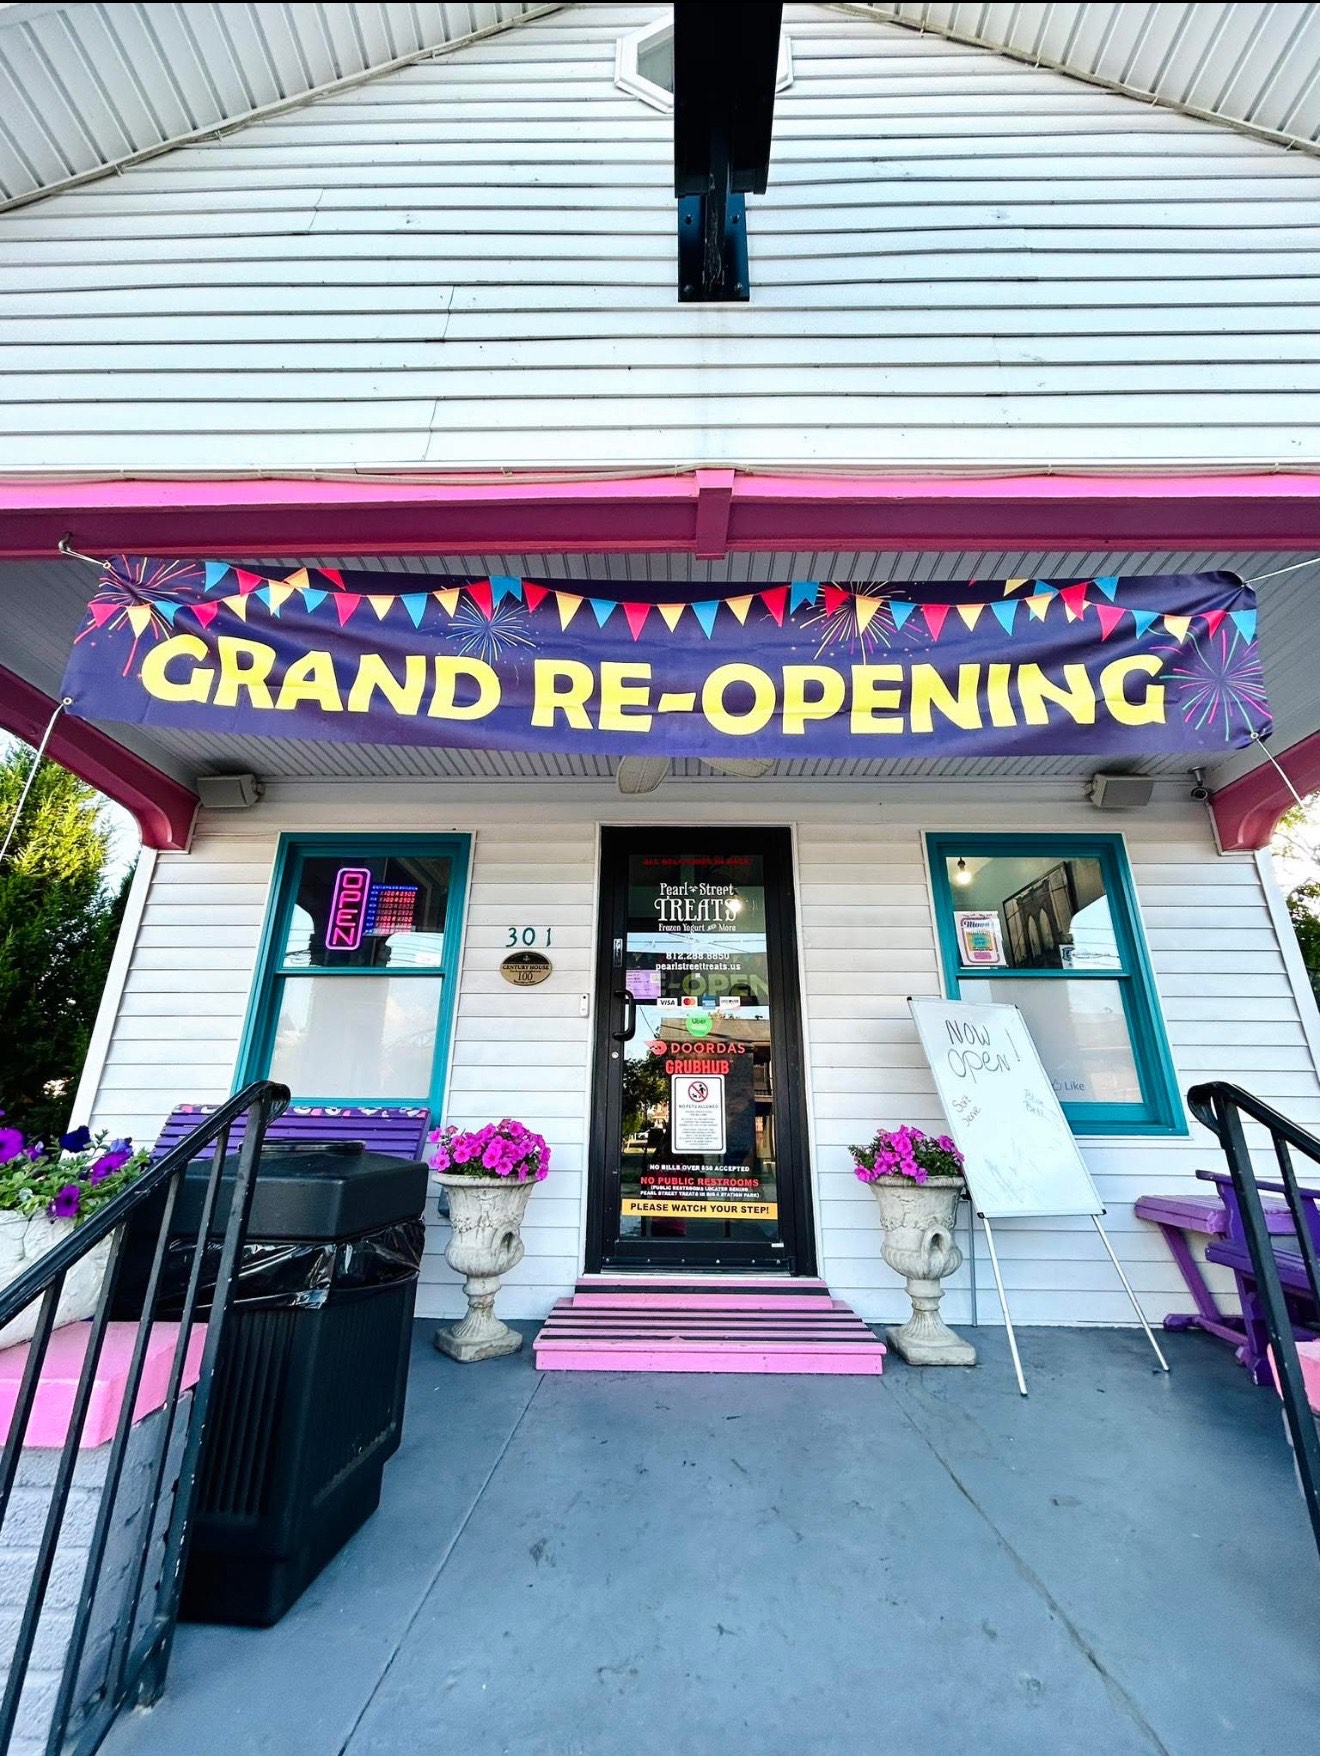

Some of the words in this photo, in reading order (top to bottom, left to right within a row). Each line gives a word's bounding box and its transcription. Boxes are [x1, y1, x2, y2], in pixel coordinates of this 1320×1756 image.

[140, 633, 501, 721] GRAND
[531, 653, 1166, 735] RE-OPENING
[660, 881, 689, 896] Pearl
[699, 883, 735, 896] Street
[332, 873, 363, 945] OPEN
[654, 896, 739, 922] TREATS
[658, 923, 681, 932] Frozen
[682, 923, 705, 933] Yogurt
[718, 923, 737, 932] More
[505, 927, 551, 948] 301
[655, 962, 742, 971] pearlstreettreats.us
[518, 972, 533, 980] 100
[945, 1020, 990, 1046] NOW
[665, 1059, 730, 1075] GRUBHUB
[1065, 1081, 1084, 1091] Like
[640, 1176, 655, 1184] NO
[657, 1177, 694, 1185] PUBLIC
[697, 1177, 759, 1187] RESTROOMS
[630, 1202, 669, 1212] PLEASE
[671, 1203, 707, 1213] WATCH
[711, 1205, 738, 1213] YOUR
[740, 1206, 769, 1214] STEP!
